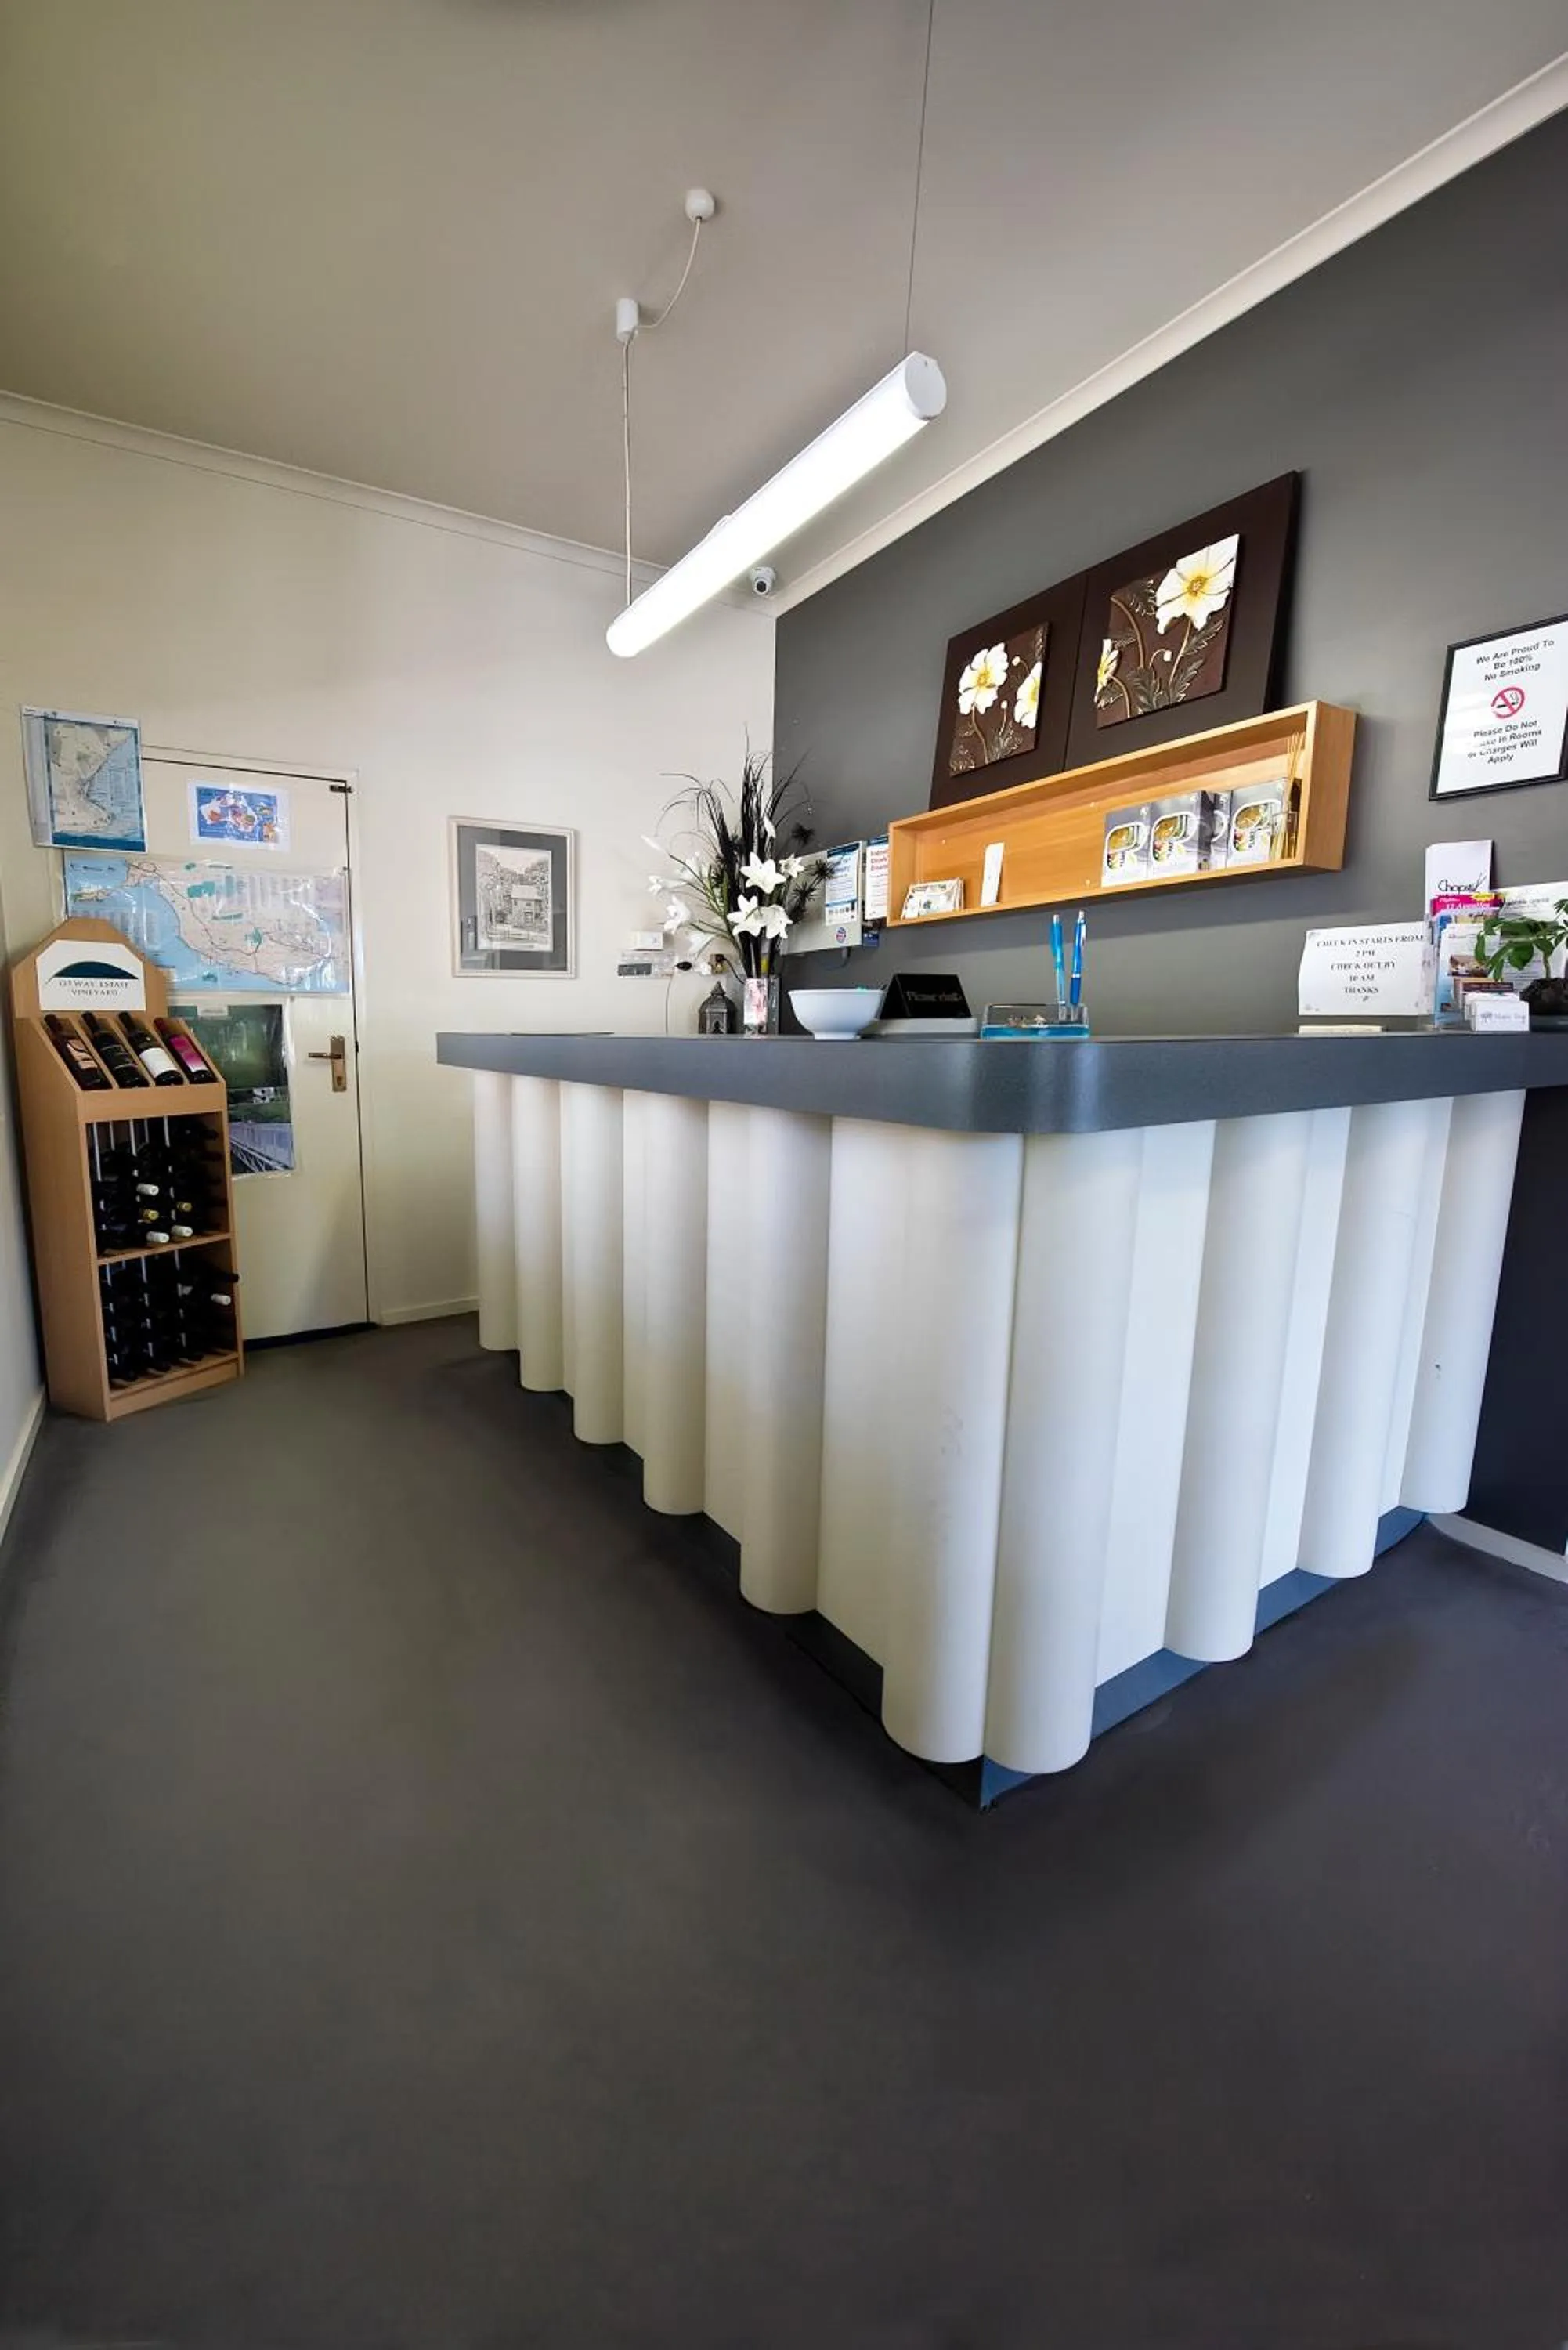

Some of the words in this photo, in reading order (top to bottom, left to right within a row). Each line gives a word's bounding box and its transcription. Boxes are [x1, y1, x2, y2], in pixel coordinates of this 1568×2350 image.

[1476, 656, 1490, 665] We
[1492, 653, 1508, 661] Are
[1511, 642, 1540, 656] Proud
[1543, 639, 1555, 648] To
[1494, 661, 1506, 670] Be
[1509, 654, 1533, 666] 100%
[1484, 673, 1497, 682] No
[1499, 663, 1541, 678] Smoking
[1473, 727, 1503, 738] Please
[1505, 724, 1519, 732] Do
[1521, 720, 1537, 728] Not
[1509, 729, 1542, 741] Rooms
[1520, 739, 1537, 749] Will
[1487, 753, 1514, 765] Apply
[1395, 934, 1425, 943] FROM
[1343, 985, 1379, 994] THANKS
